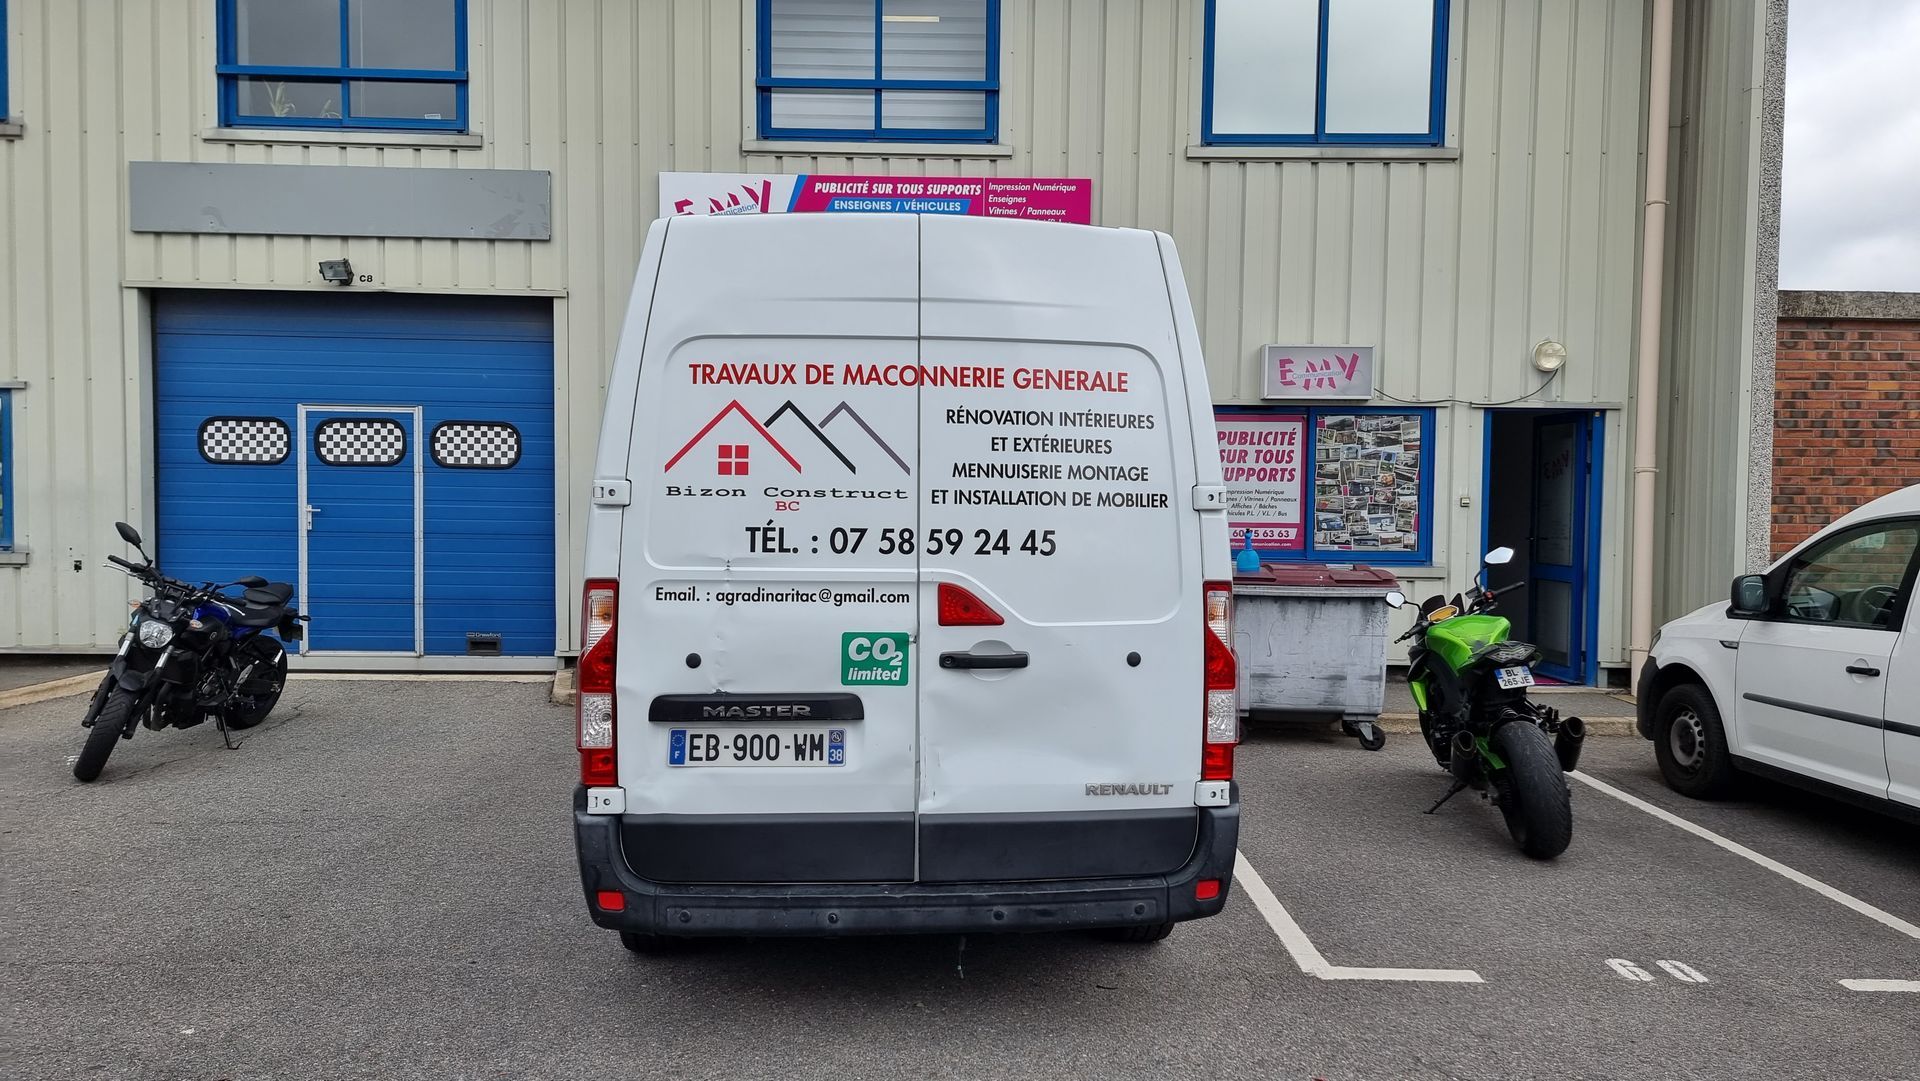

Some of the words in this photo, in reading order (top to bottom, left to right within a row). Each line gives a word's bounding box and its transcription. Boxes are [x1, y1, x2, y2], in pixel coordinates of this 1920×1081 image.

[814, 181, 868, 194] PUBLICITÉ
[871, 184, 893, 194] SUR
[897, 184, 924, 194] TOUS
[926, 185, 981, 195] SUPPORTS
[988, 182, 1031, 193] Impression
[1032, 183, 1076, 193] Numérique
[834, 201, 892, 210] ENSEIGNES
[903, 199, 961, 211] VÉHICULES
[988, 194, 1027, 205] Enseignes
[988, 206, 1018, 215] Vitrines
[1027, 207, 1067, 216] Panneaux
[359, 274, 373, 283] C8
[689, 363, 797, 385] TRAVAUX
[805, 364, 835, 385] DE
[843, 364, 1005, 389] MACONNERIE
[1012, 367, 1129, 392] GENERALE
[946, 405, 1054, 427] RÉNOVATION
[1059, 408, 1155, 430] INTÉRIEURES
[991, 437, 1008, 452] ET
[1013, 433, 1113, 455] EXTÉRIEURES
[1217, 427, 1297, 446] PUBLICITÉ
[1219, 449, 1248, 464] SUR
[1255, 449, 1295, 464] TOUS
[952, 462, 1062, 480] MENNUISERIE
[1067, 464, 1149, 482] MONTAGE
[1221, 467, 1297, 482] UPPORTS
[666, 486, 747, 497] Bizon
[763, 486, 909, 500] Construct
[931, 490, 948, 505] ET
[954, 489, 1066, 507] INSTALLATION
[1072, 492, 1092, 507] DE
[1097, 492, 1169, 509] MOBILIER
[775, 501, 800, 512] BC
[745, 519, 799, 554] TÉL.
[811, 535, 819, 554] :
[829, 527, 869, 555] 07
[878, 527, 915, 555] 58
[926, 528, 964, 556] 59
[974, 529, 1010, 555] 24
[1020, 530, 1057, 557] 45
[655, 587, 700, 601] Email.
[715, 587, 910, 607] agradinaritac@gmail.com
[847, 667, 902, 681] limited
[703, 704, 811, 718] MASTER
[674, 751, 680, 759] F
[688, 733, 824, 762] EB-900-WM
[829, 749, 843, 762] 38
[1085, 783, 1174, 796] RENAULT
[1604, 958, 1710, 982] 60
